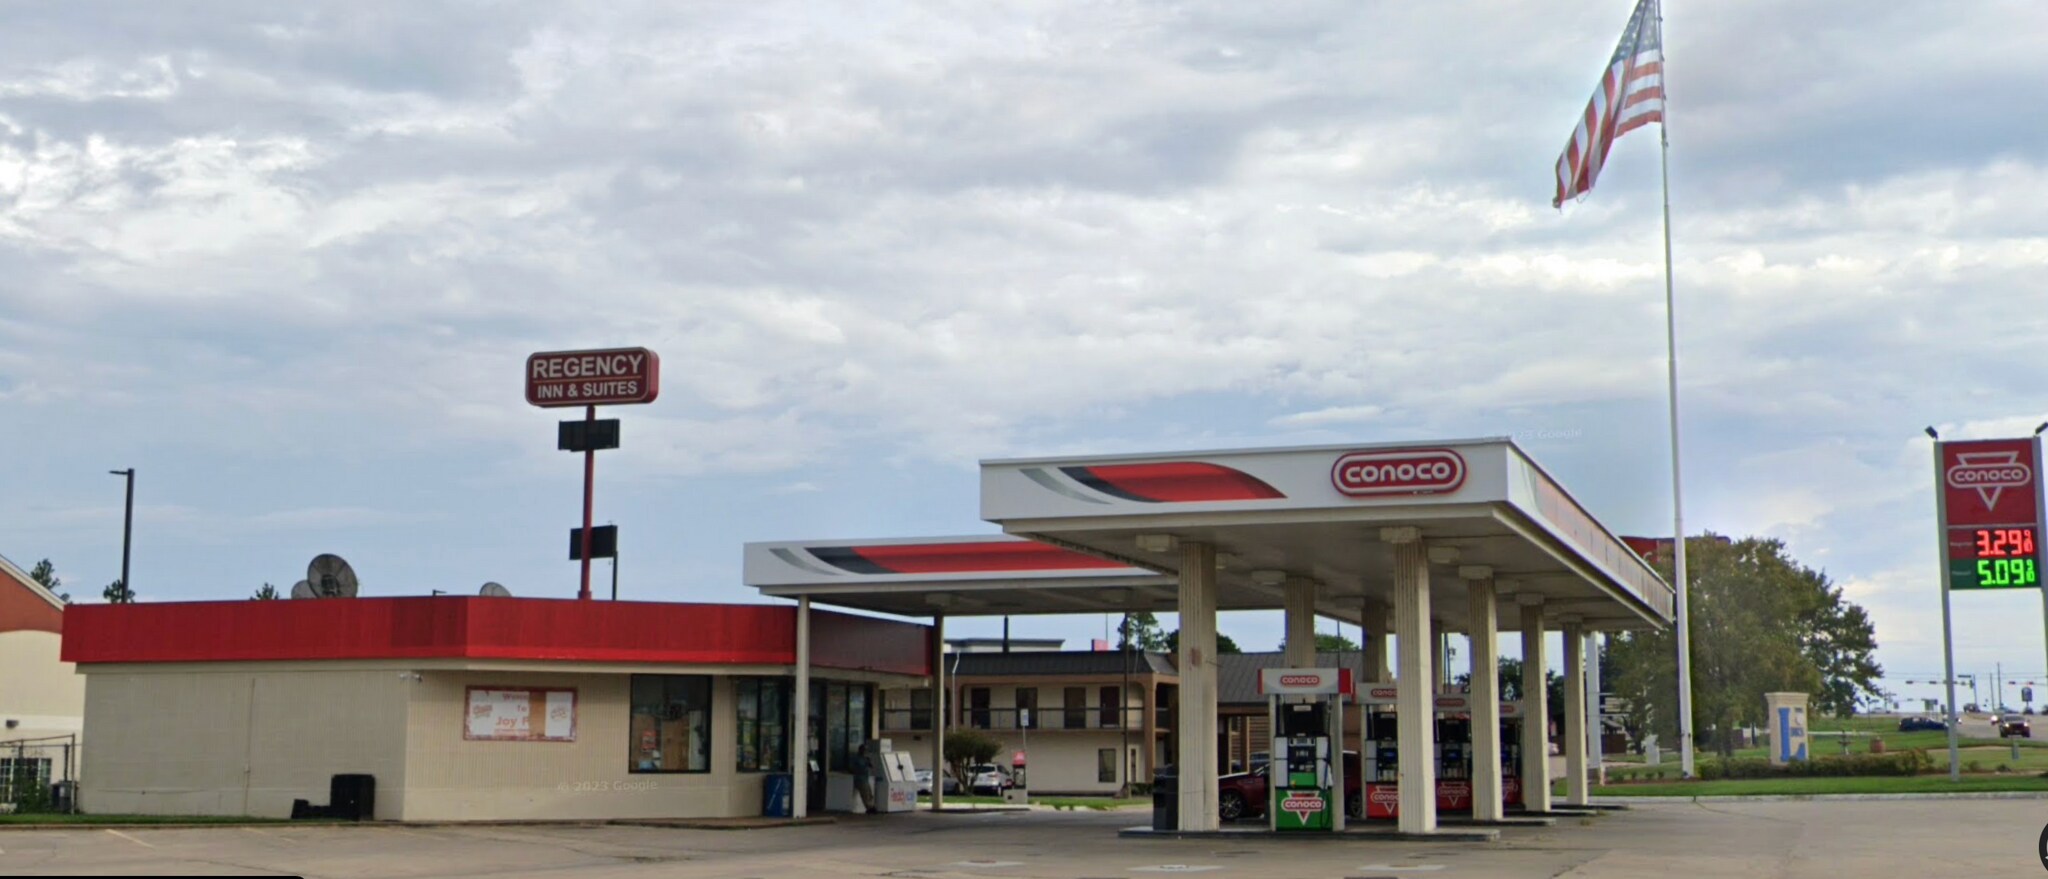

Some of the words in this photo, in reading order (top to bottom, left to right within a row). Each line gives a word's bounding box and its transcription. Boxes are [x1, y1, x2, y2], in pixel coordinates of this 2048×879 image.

[533, 355, 643, 378] REGENCY
[537, 384, 562, 398] INN
[567, 383, 578, 397] &
[582, 381, 637, 396] SUITES
[1977, 529, 2022, 556] 3.29
[1977, 559, 2025, 585] 5.09
[496, 716, 517, 728] Joy
